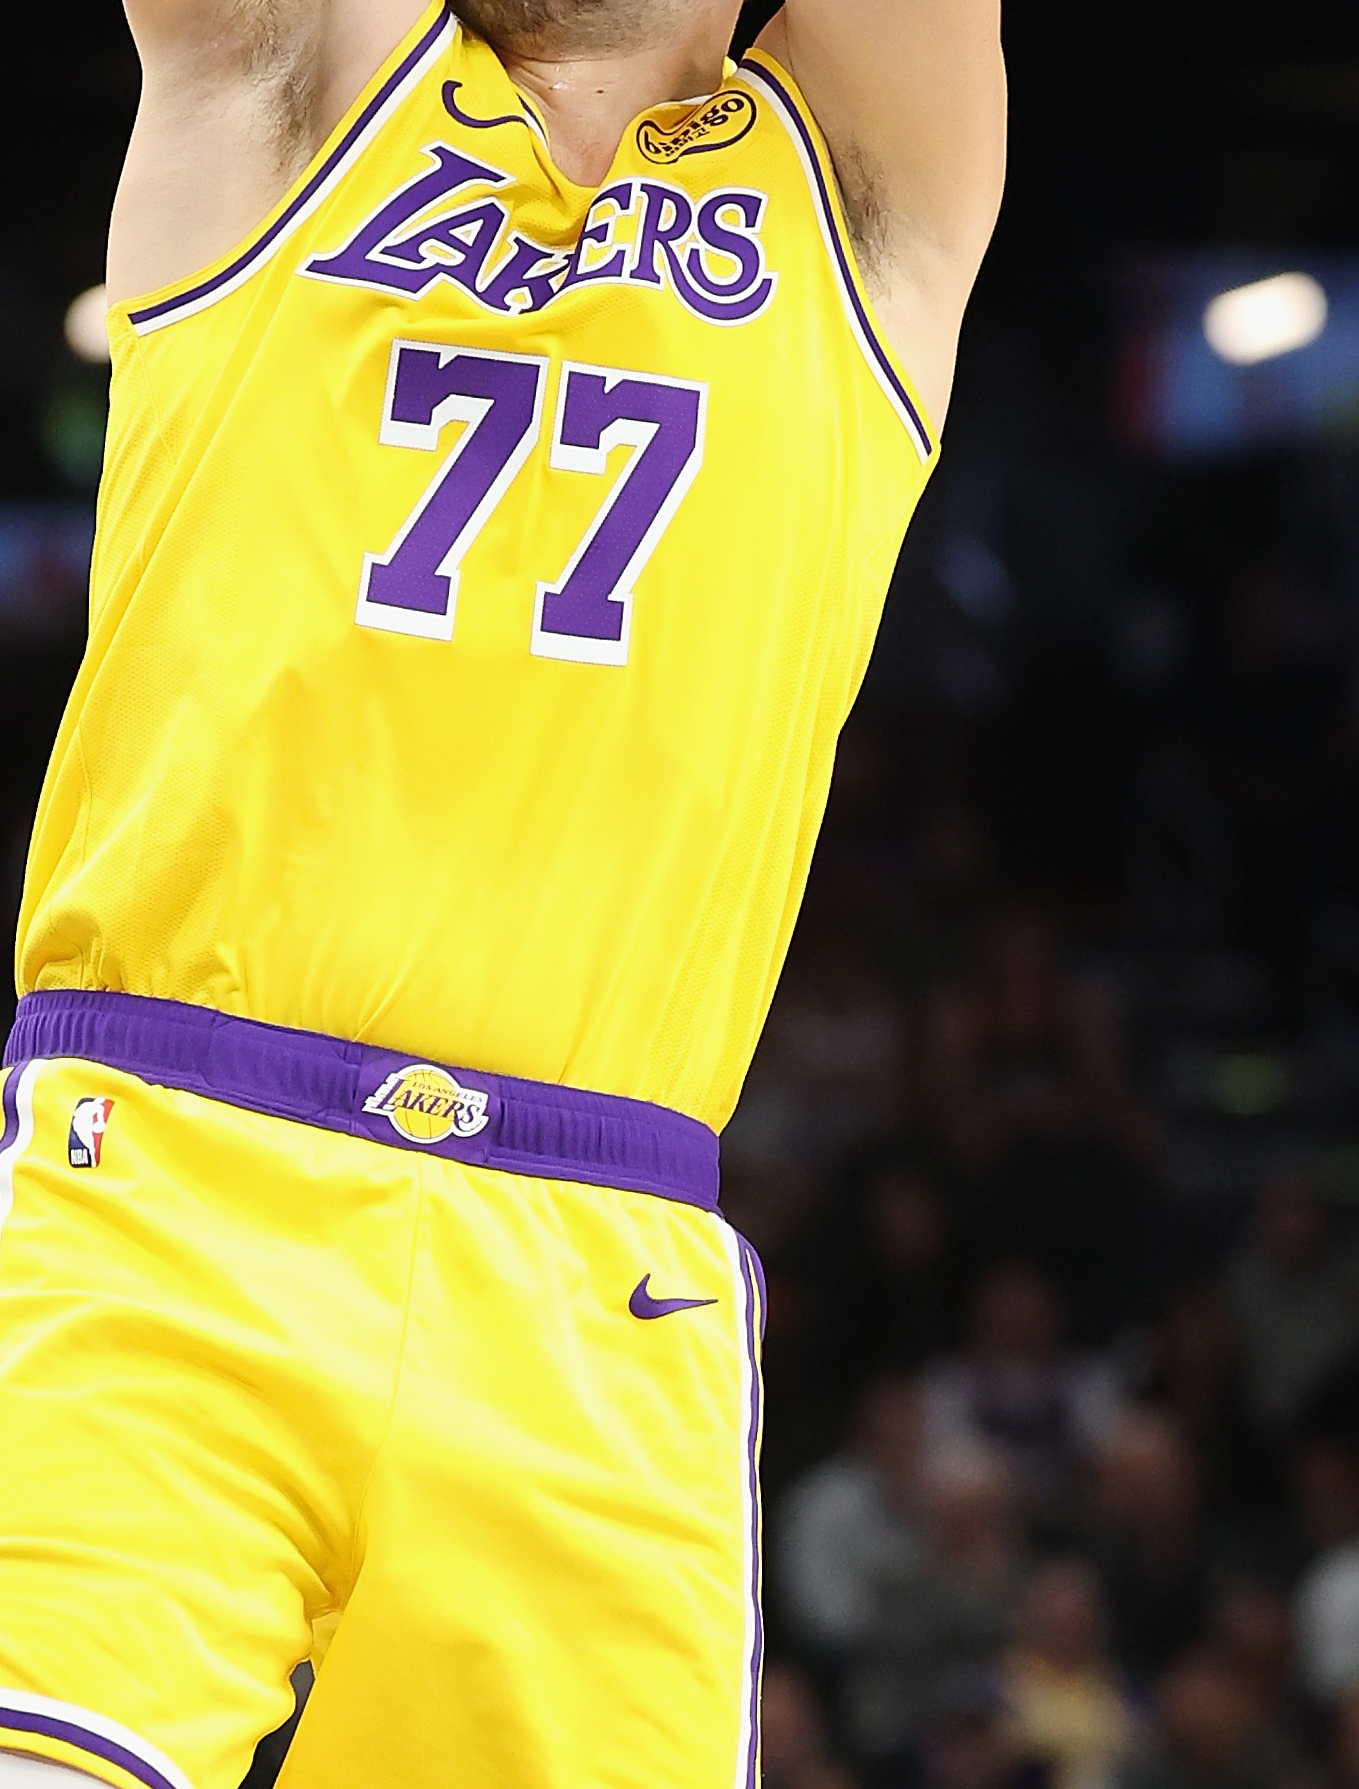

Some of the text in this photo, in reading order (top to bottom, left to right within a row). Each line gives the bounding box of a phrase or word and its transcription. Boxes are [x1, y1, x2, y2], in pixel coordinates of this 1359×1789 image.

[298, 141, 778, 326] LAKERS
[355, 338, 709, 666] 77
[374, 1078, 483, 1132] LAKERS
[412, 1082, 483, 1103] LOS ANGELES
